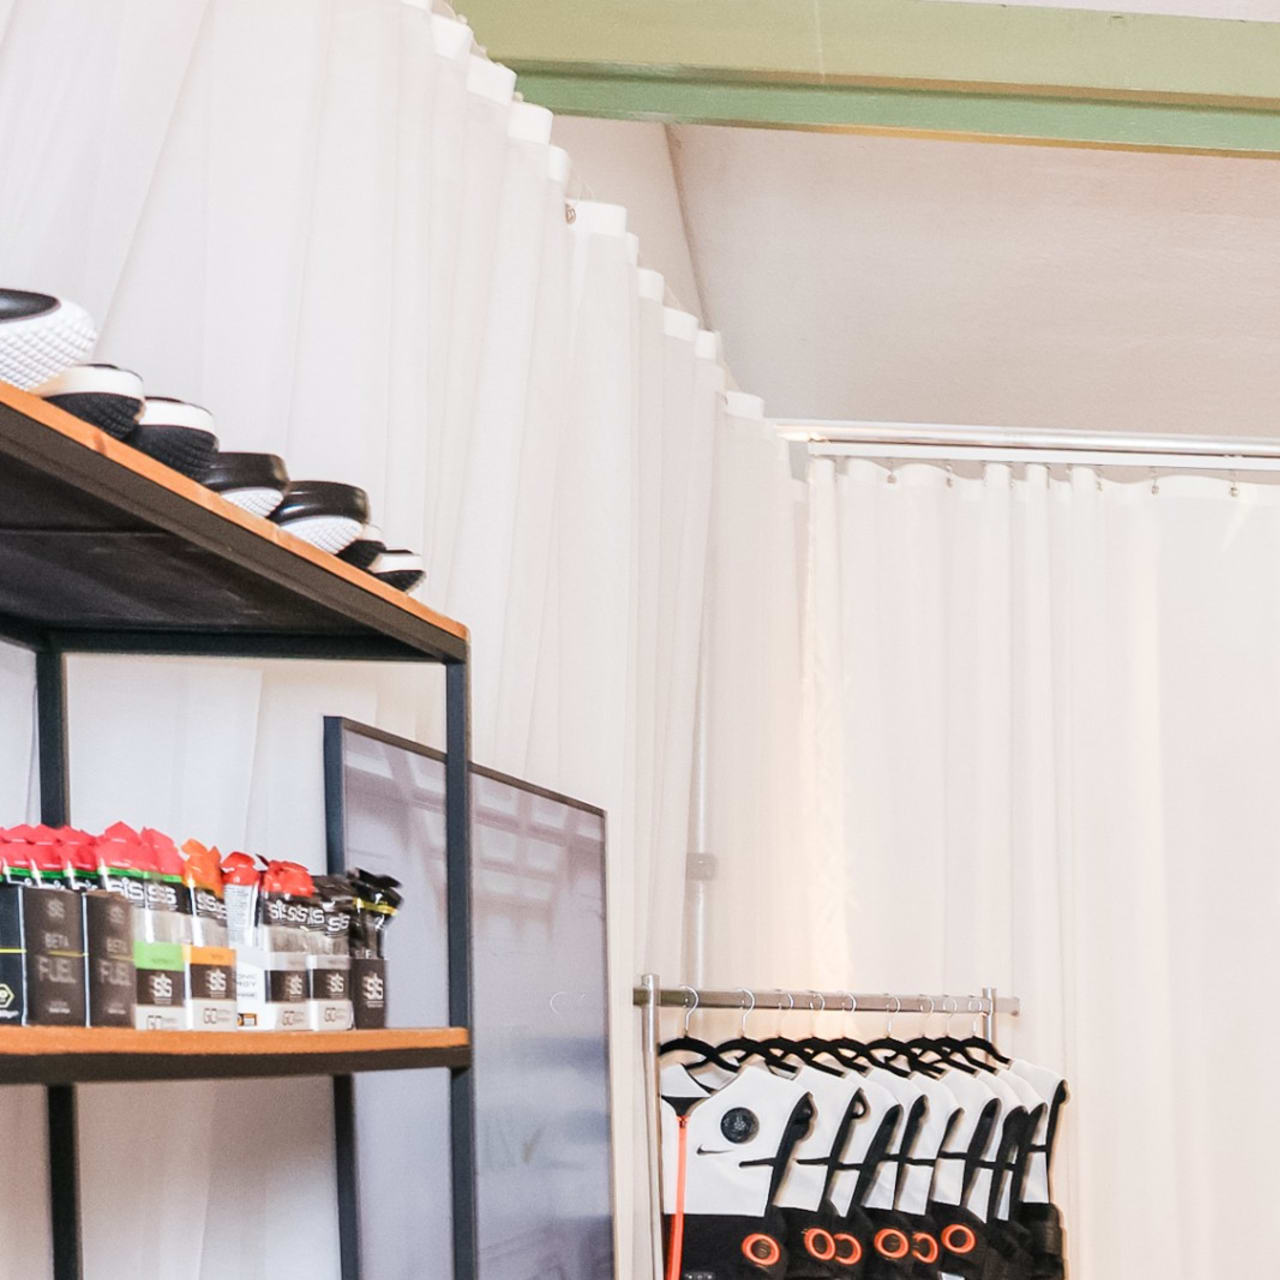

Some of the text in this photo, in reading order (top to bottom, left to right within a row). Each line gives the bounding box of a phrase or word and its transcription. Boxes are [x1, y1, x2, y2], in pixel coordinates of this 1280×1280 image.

[44, 932, 70, 949] BETA
[36, 955, 76, 984] FUEL
[98, 960, 132, 987] FUEL
